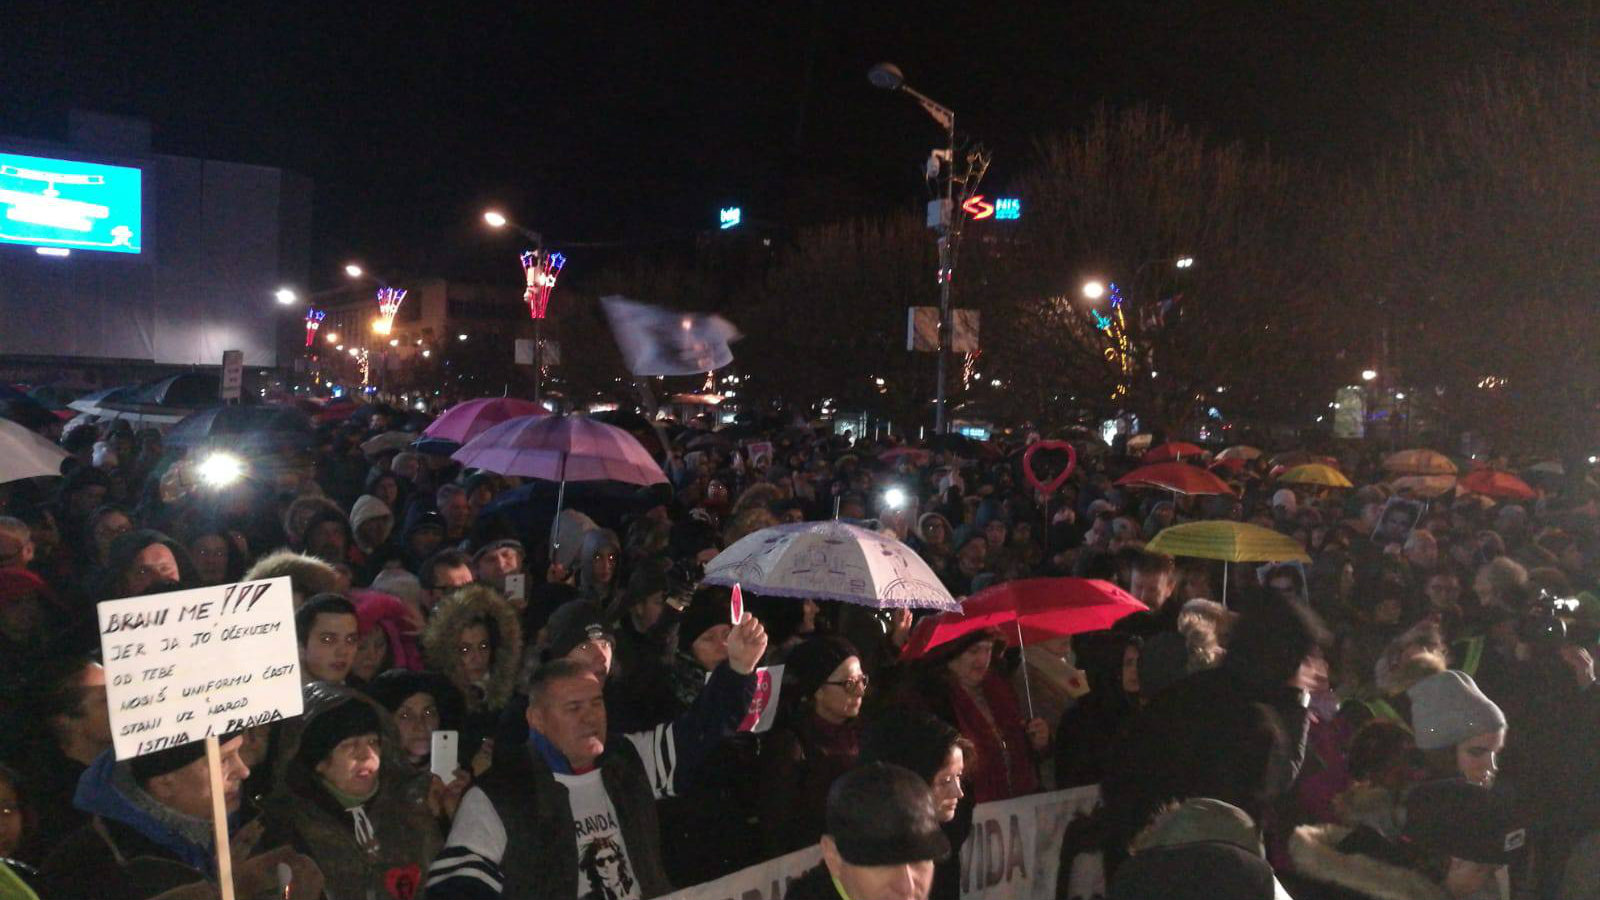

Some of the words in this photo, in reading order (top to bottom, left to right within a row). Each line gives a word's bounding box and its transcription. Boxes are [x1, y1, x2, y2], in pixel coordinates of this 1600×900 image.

[103, 608, 169, 635] BRANI
[110, 643, 147, 661] JER
[160, 637, 180, 653] JA
[190, 632, 211, 648] TO
[113, 673, 133, 687] OD
[142, 664, 177, 682] TEBE
[182, 675, 253, 698] UNIFORMU
[119, 717, 163, 737] STANI
[176, 710, 195, 723] UZ
[207, 696, 249, 716] NAROD
[136, 731, 190, 757] ISTINA
[225, 708, 283, 733] PRAVDA
